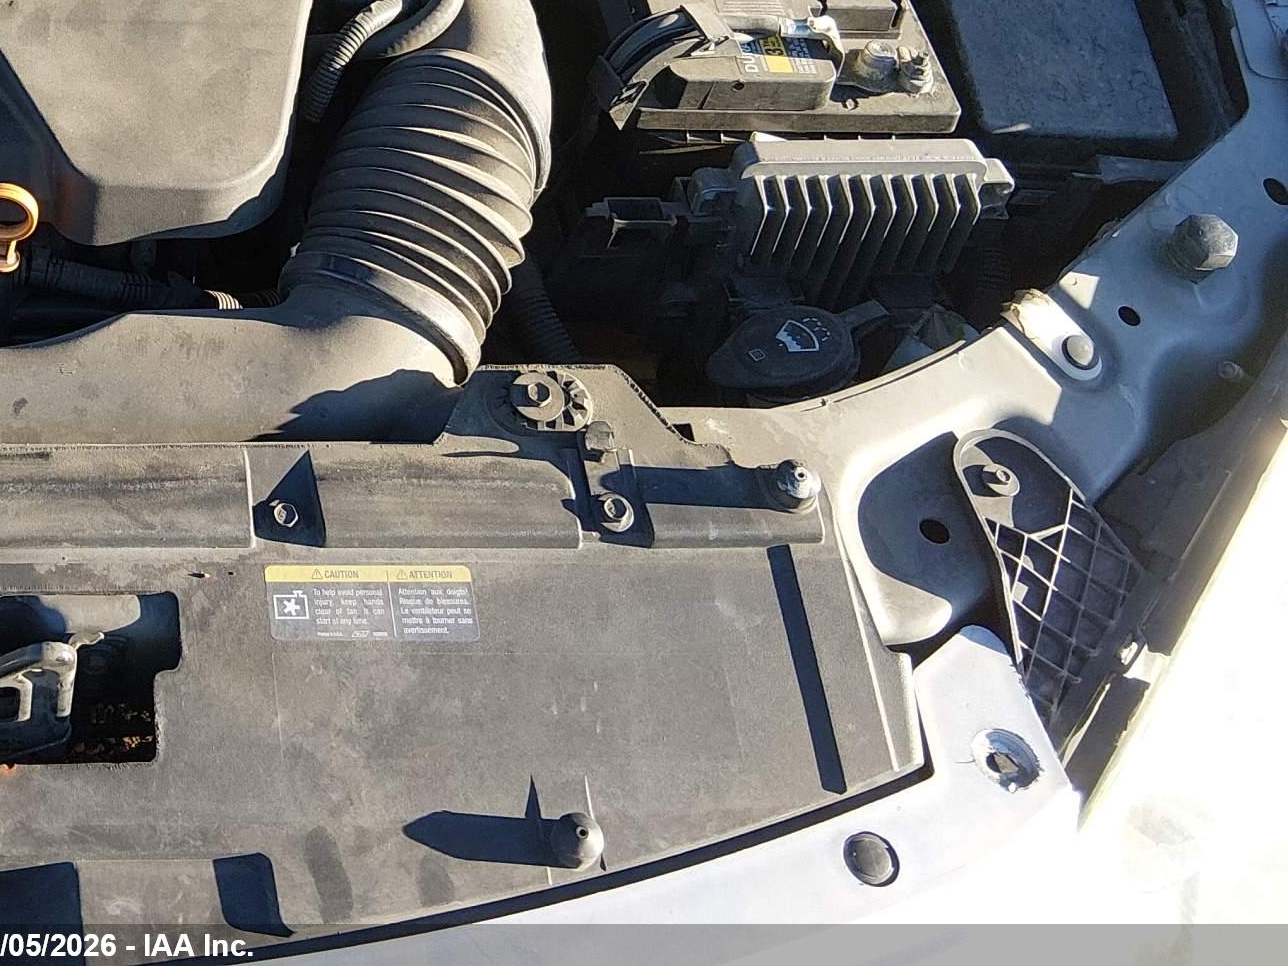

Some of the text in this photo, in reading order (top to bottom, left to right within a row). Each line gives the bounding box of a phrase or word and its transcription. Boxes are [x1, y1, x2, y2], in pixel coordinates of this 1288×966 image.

[324, 570, 359, 579] CAUTION
[409, 570, 453, 579] ATTENTION
[313, 588, 321, 596] To
[322, 588, 336, 597] help
[337, 588, 354, 596] avoid
[398, 587, 427, 595] Attention
[363, 598, 384, 606] hands
